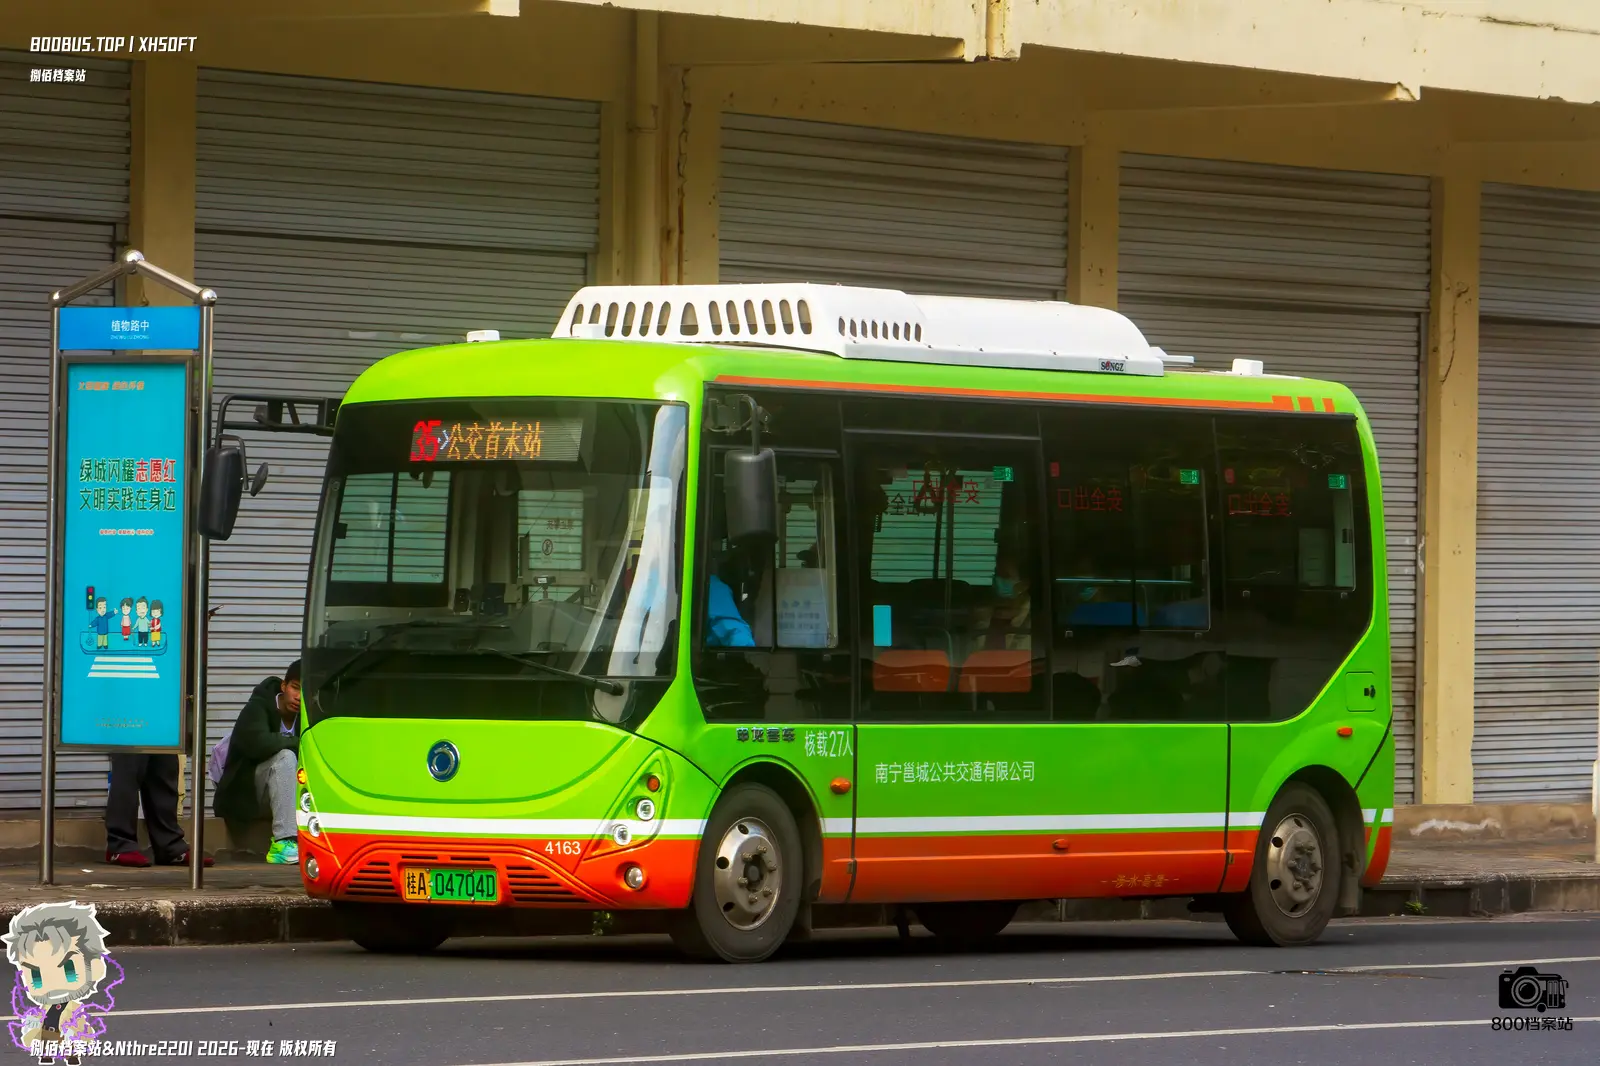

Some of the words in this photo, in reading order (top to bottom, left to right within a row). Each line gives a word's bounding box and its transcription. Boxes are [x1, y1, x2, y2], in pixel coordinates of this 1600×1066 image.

[111, 319, 150, 332] 植物路中
[1100, 361, 1124, 371] SONGZ
[410, 420, 442, 461] 35
[447, 421, 545, 460] 公交首末站
[79, 458, 176, 483] 绿城闪耀志愿红
[79, 486, 176, 511] 文明实践在身边
[804, 730, 854, 757] 核载27人
[875, 761, 1035, 783] 南宁邕城公共交通有限公司
[545, 841, 581, 855] 4163
